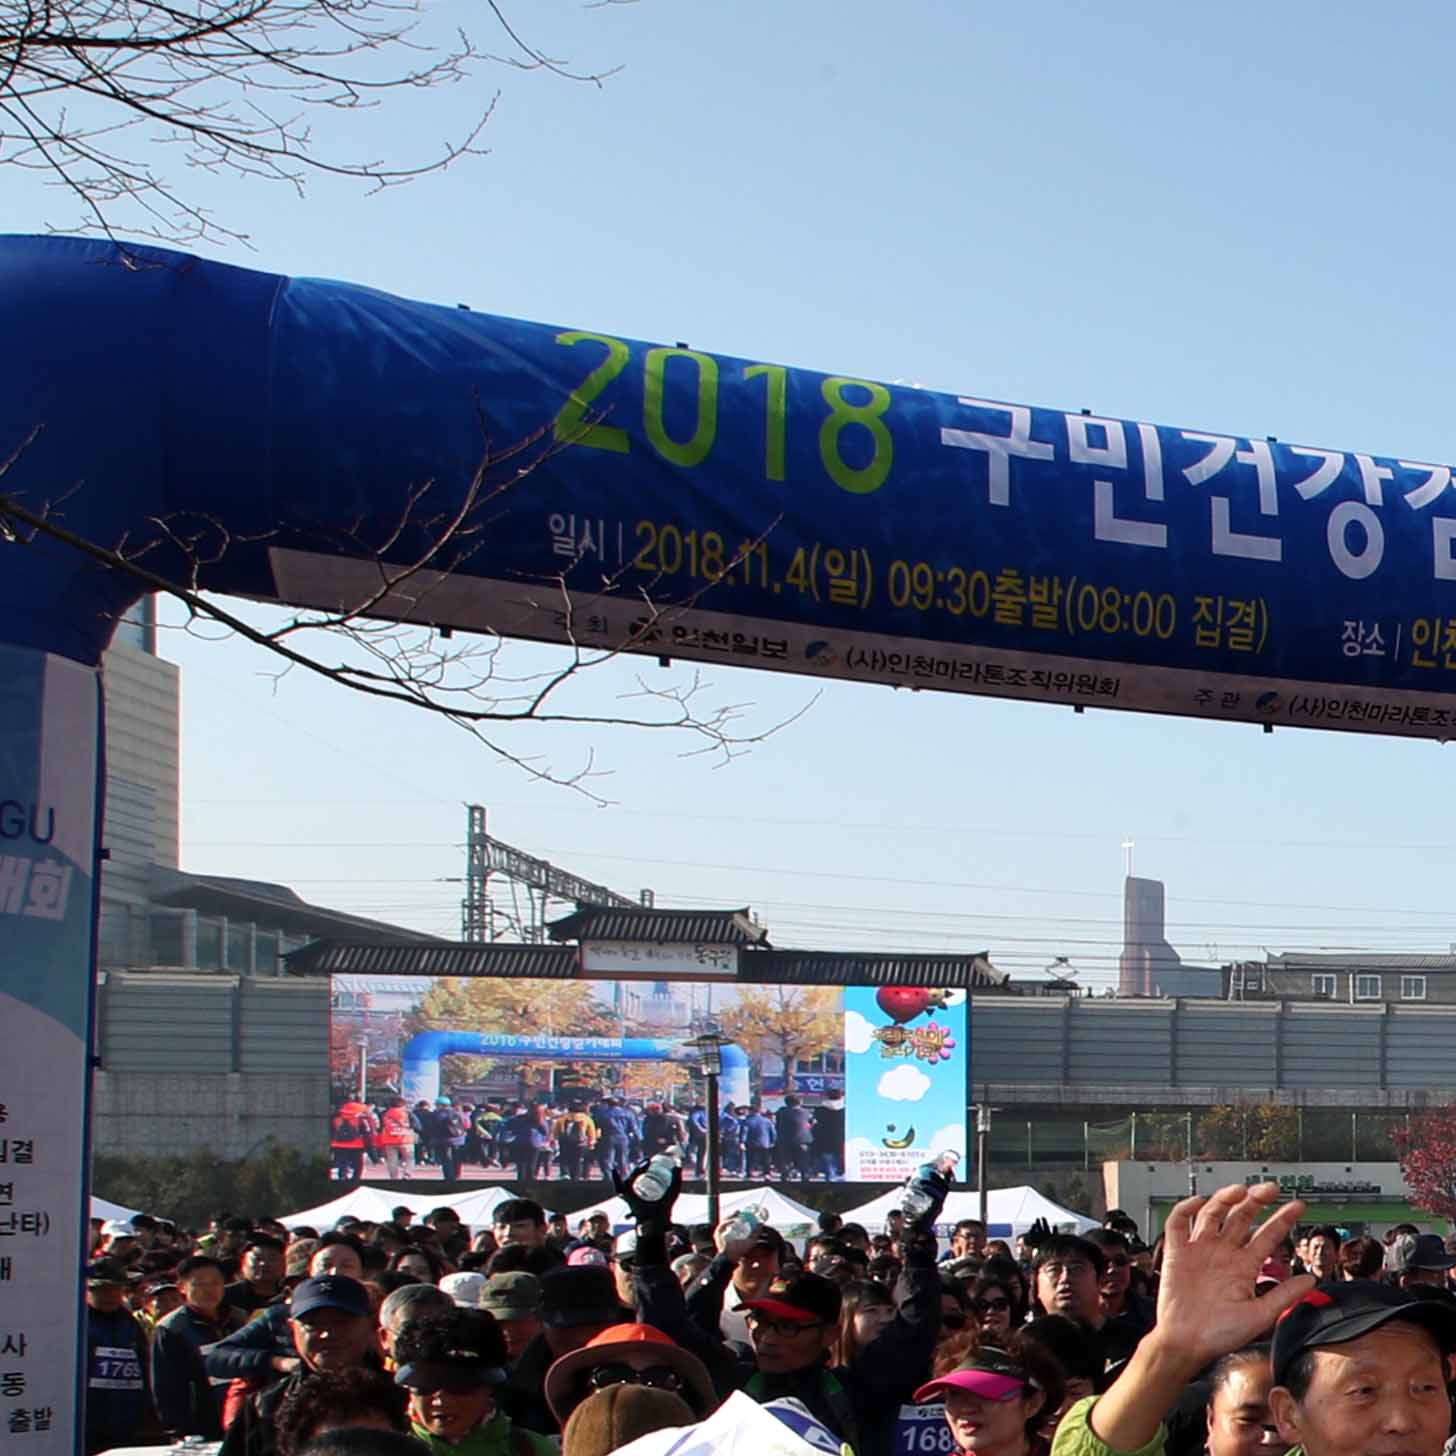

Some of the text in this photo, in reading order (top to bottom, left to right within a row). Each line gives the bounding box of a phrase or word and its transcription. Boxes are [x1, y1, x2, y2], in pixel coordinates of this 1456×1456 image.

[553, 329, 894, 494] 2018
[550, 513, 604, 560] 일시
[635, 521, 872, 608] 2018.11.4(일)
[1191, 596, 1269, 655] 집결)
[671, 625, 788, 660] 인천일보
[1341, 619, 1385, 658] 장소
[7, 1406, 53, 1433] 출발
